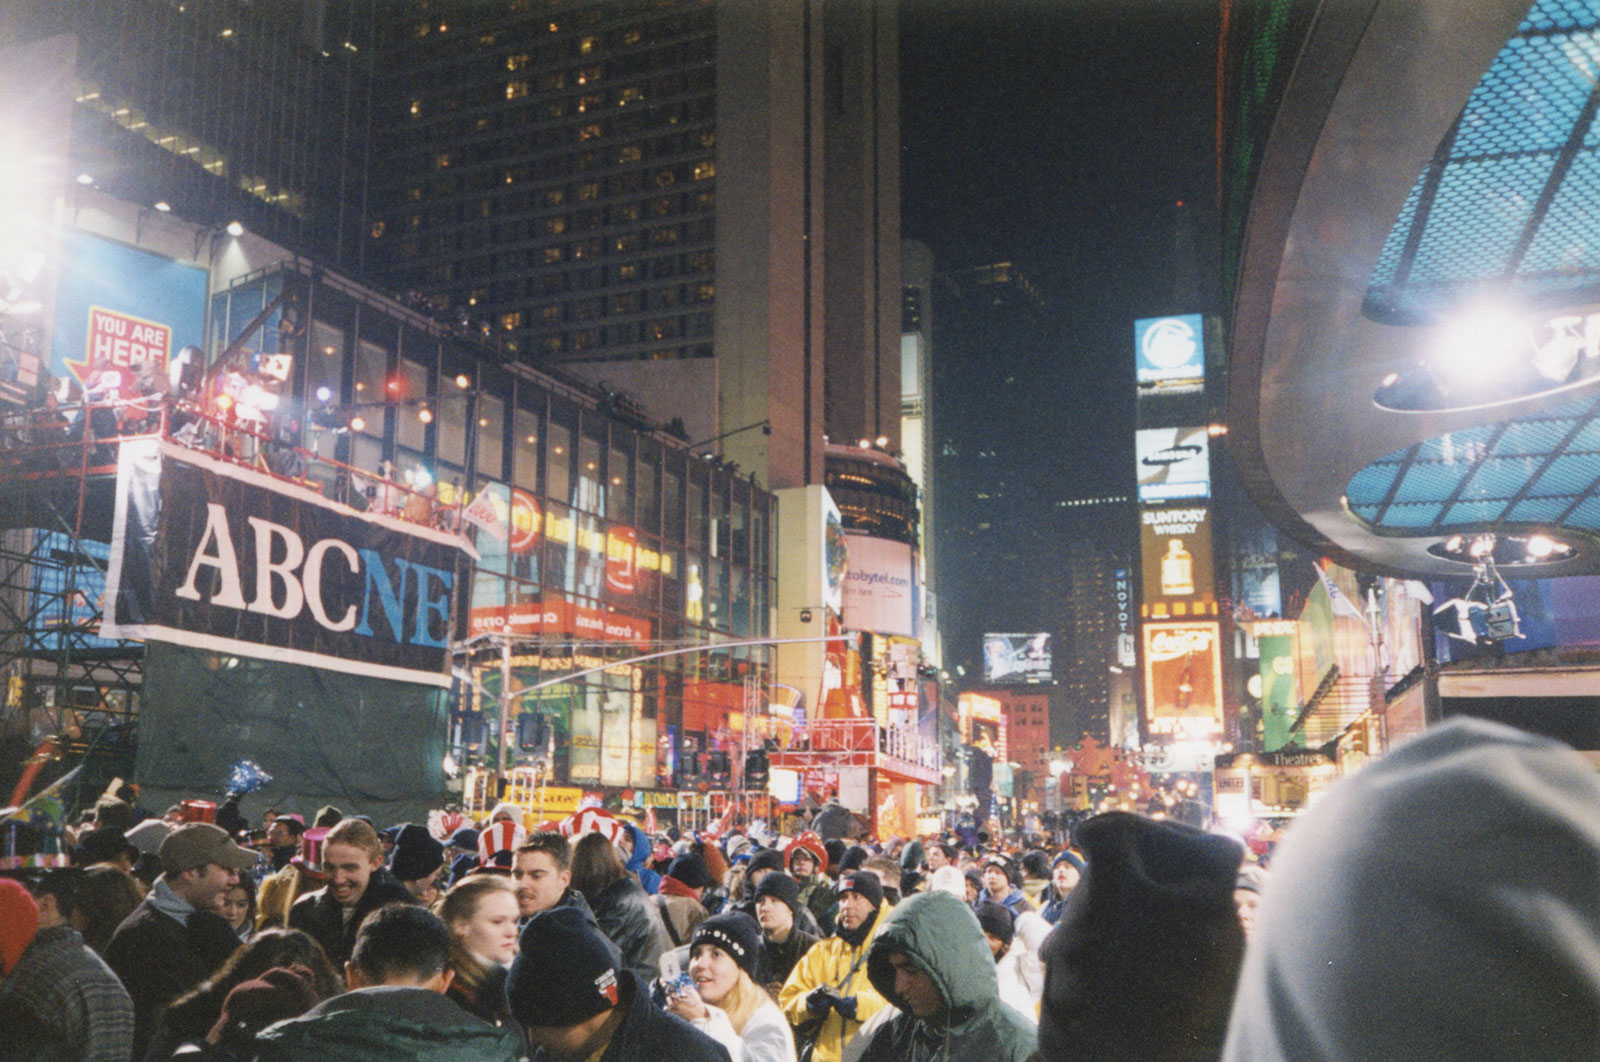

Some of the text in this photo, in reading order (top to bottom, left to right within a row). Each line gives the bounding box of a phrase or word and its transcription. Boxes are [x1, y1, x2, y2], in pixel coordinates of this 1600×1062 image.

[96, 313, 165, 348] YOU ARE
[1142, 508, 1206, 525] SUNTORY
[1274, 753, 1323, 766] Theatres
